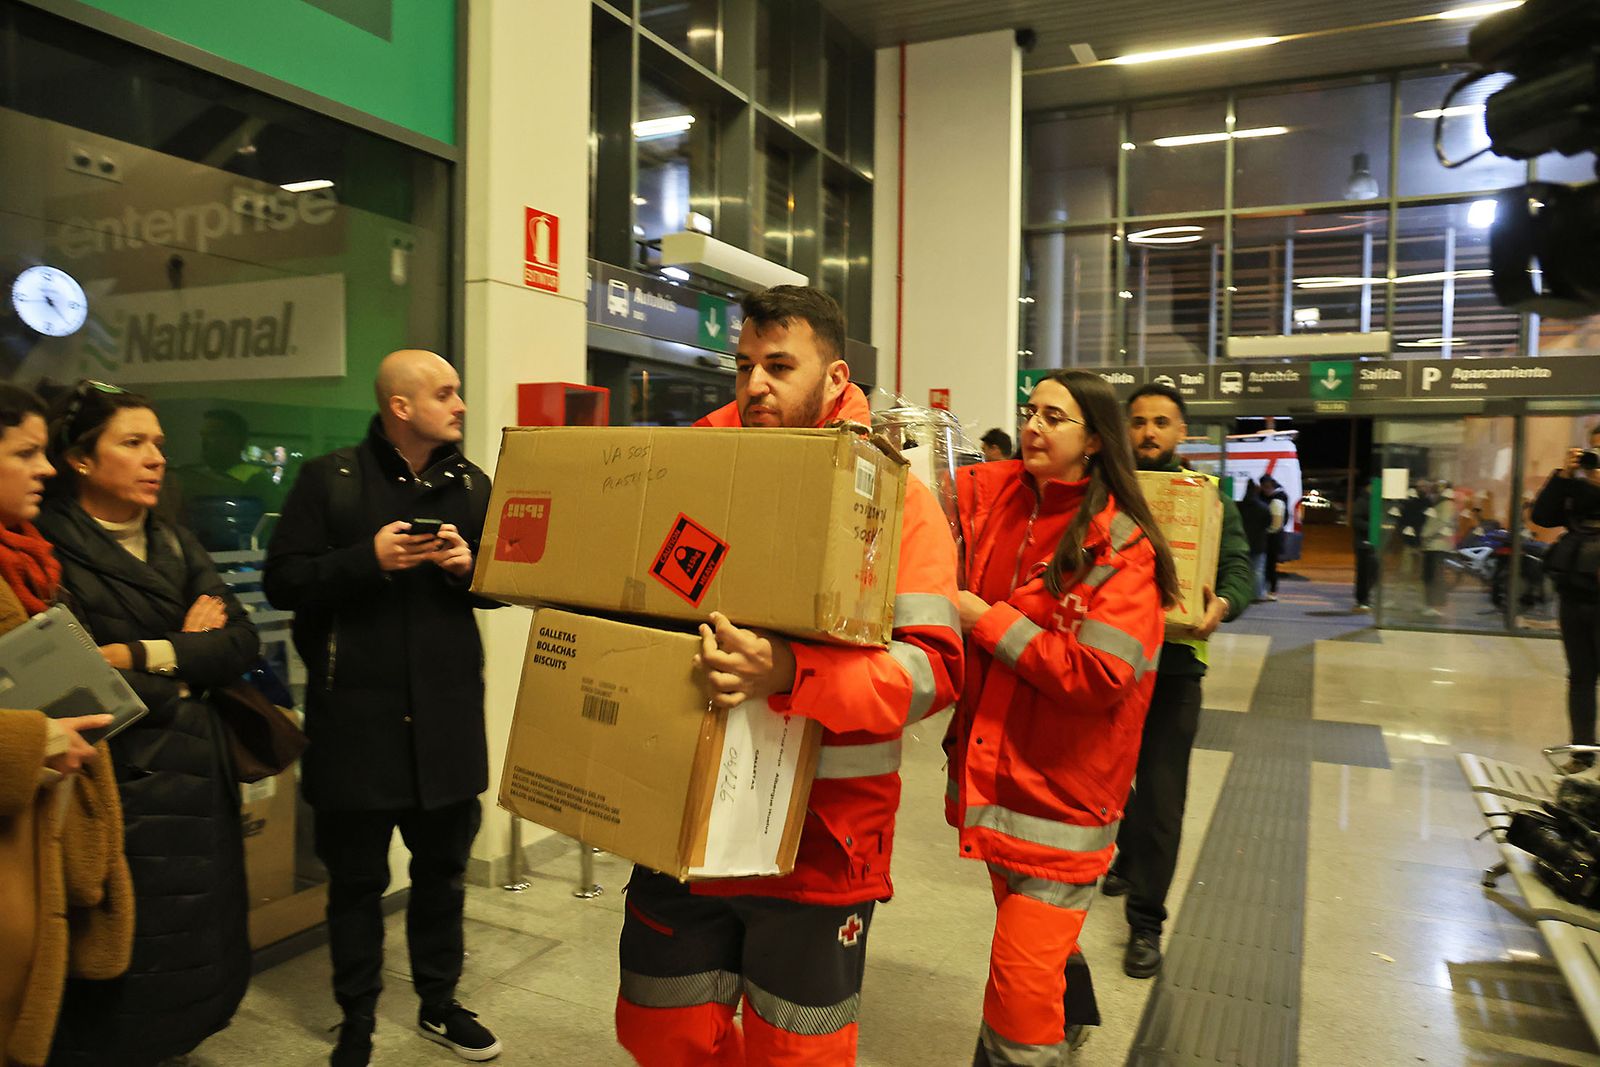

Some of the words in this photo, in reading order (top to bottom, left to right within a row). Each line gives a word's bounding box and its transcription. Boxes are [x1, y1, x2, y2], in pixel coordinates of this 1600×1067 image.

[57, 186, 338, 259] enterprise
[125, 301, 293, 364] National
[1451, 366, 1552, 381] Aparcamiento
[660, 529, 681, 564] CAUTION
[699, 560, 716, 585] HEAVY
[540, 627, 577, 643] GALLETAS
[536, 640, 577, 658] BOLACHAS
[533, 654, 567, 670] BISCUITS
